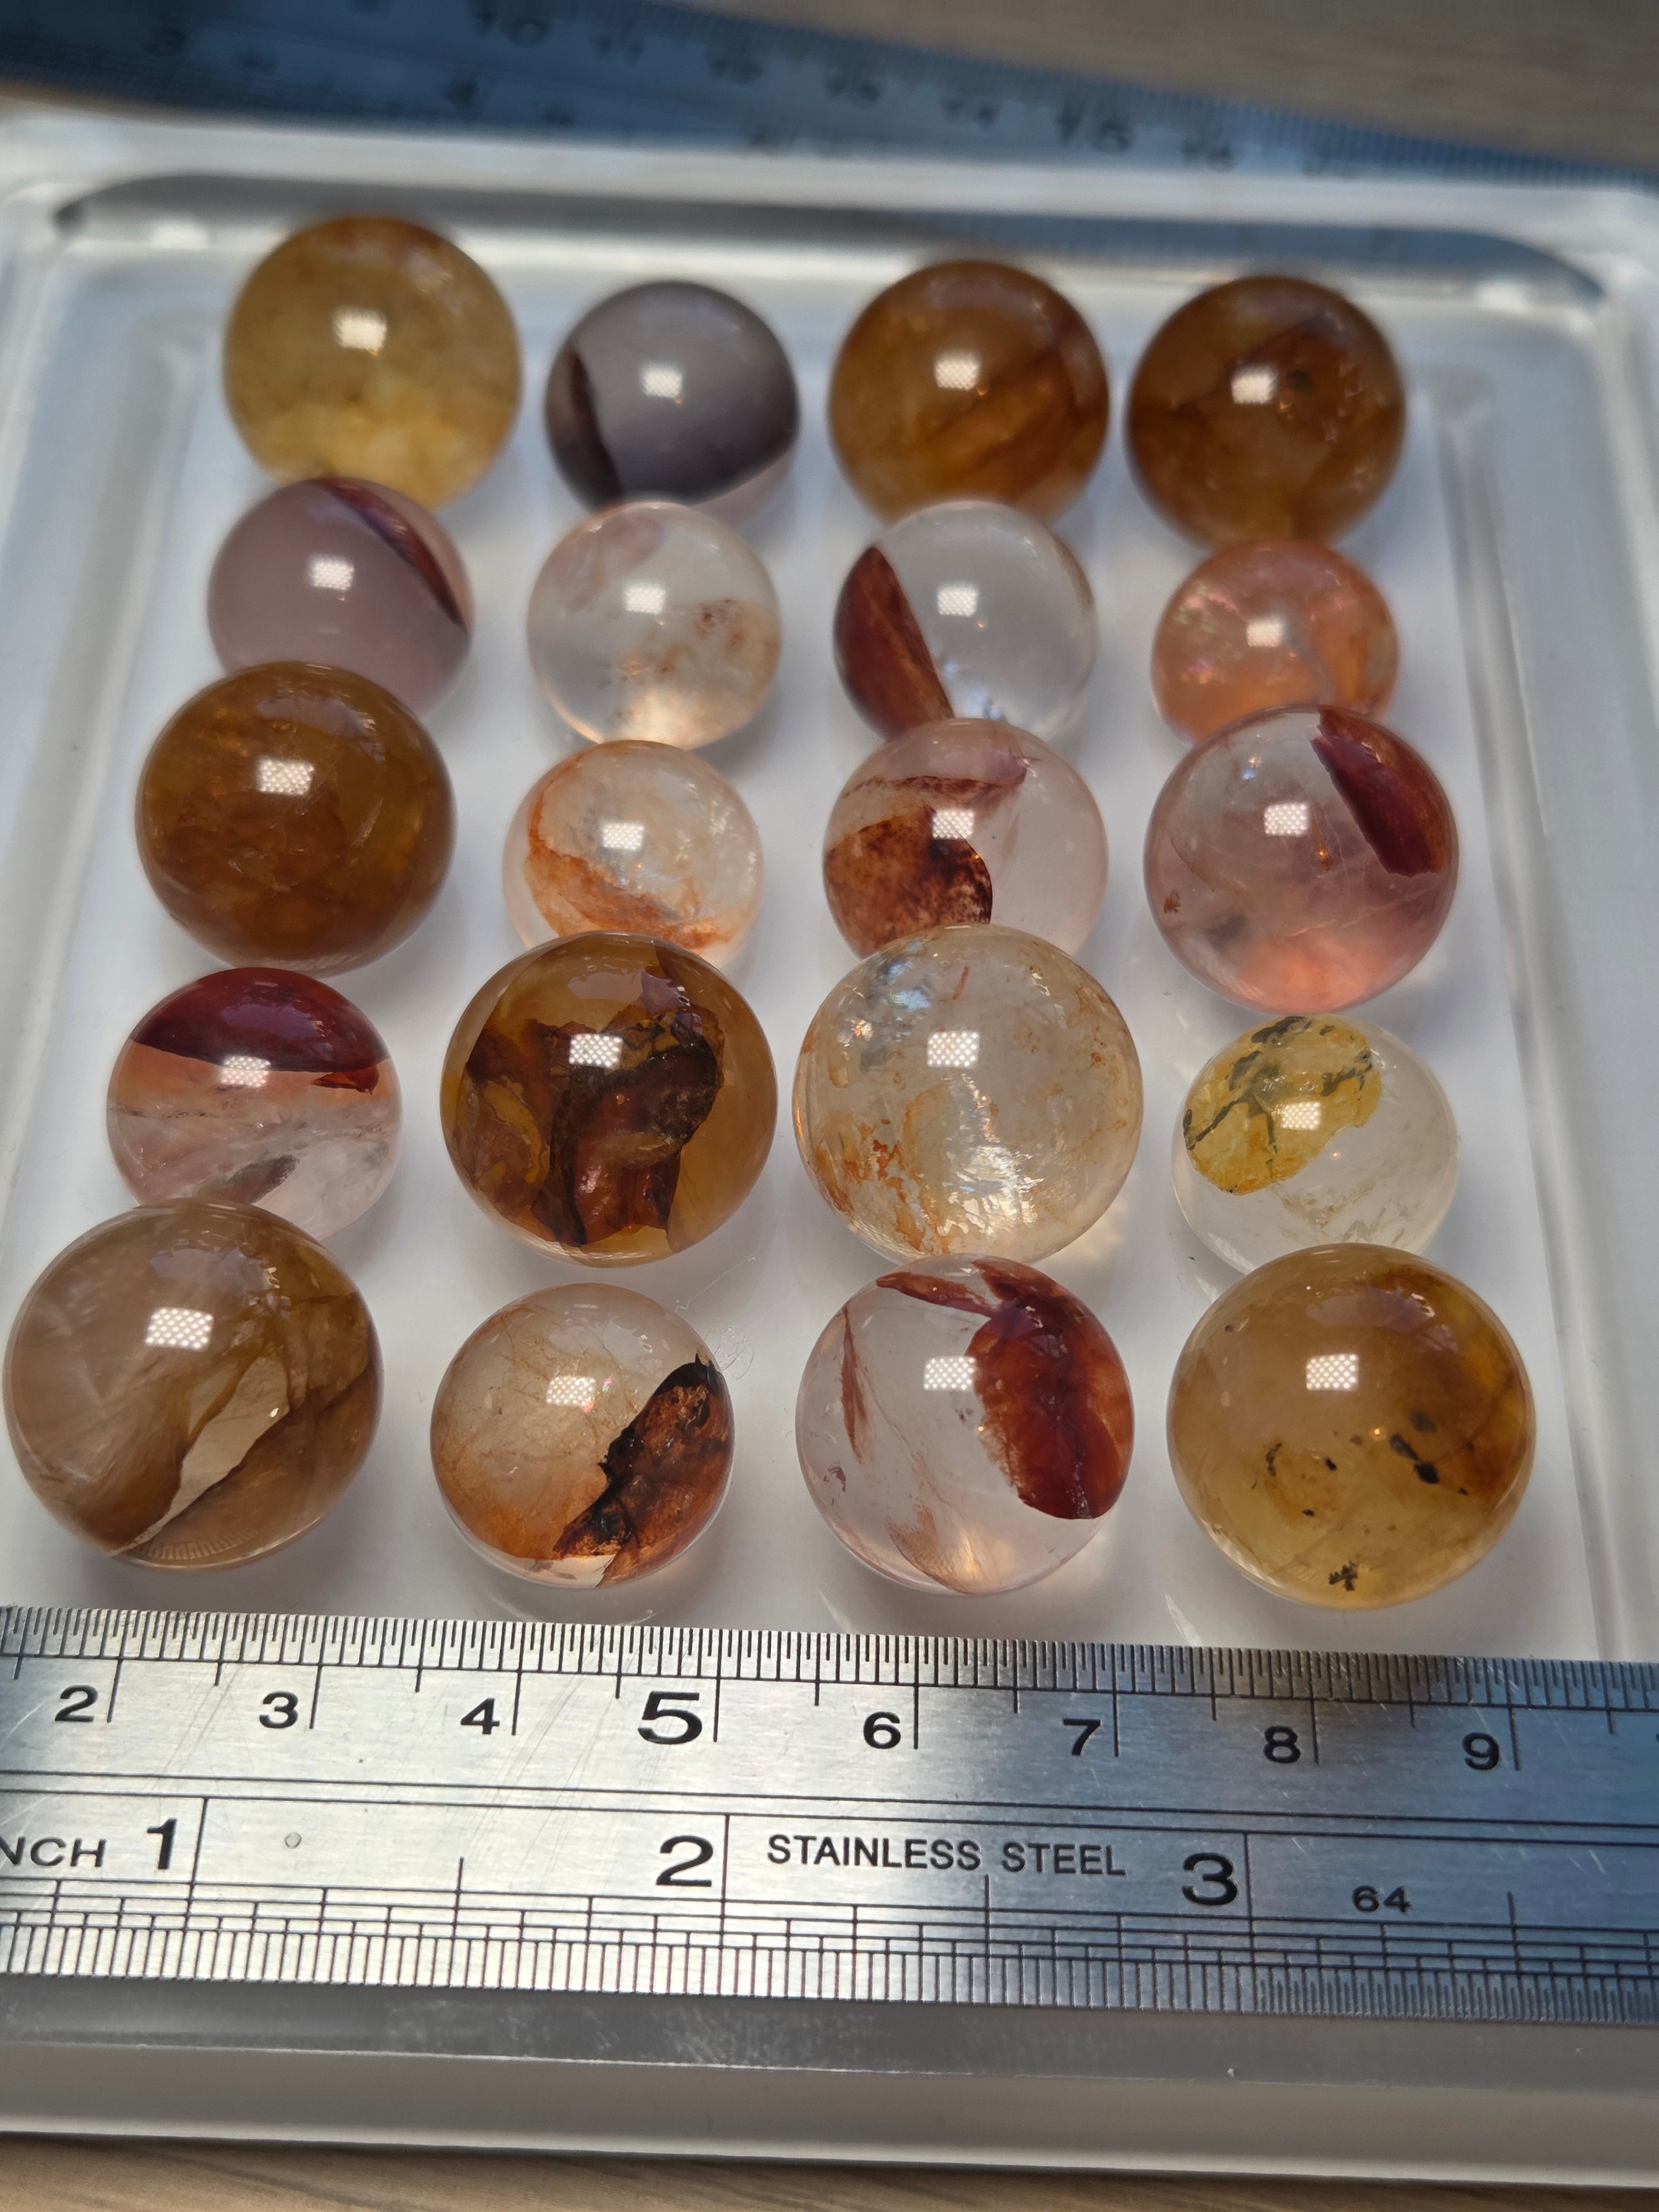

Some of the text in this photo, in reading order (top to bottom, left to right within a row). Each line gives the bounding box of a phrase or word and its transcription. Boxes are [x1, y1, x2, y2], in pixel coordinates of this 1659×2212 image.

[55, 1685, 1500, 1771] 2 3 4 5 6 7 8 9
[147, 1819, 178, 1870] 1
[655, 1835, 714, 1887] 2
[768, 1834, 982, 1871] STAINLESS
[1001, 1841, 1126, 1877] STEEL
[1181, 1853, 1238, 1907] 3
[1352, 1885, 1412, 1914] 64
